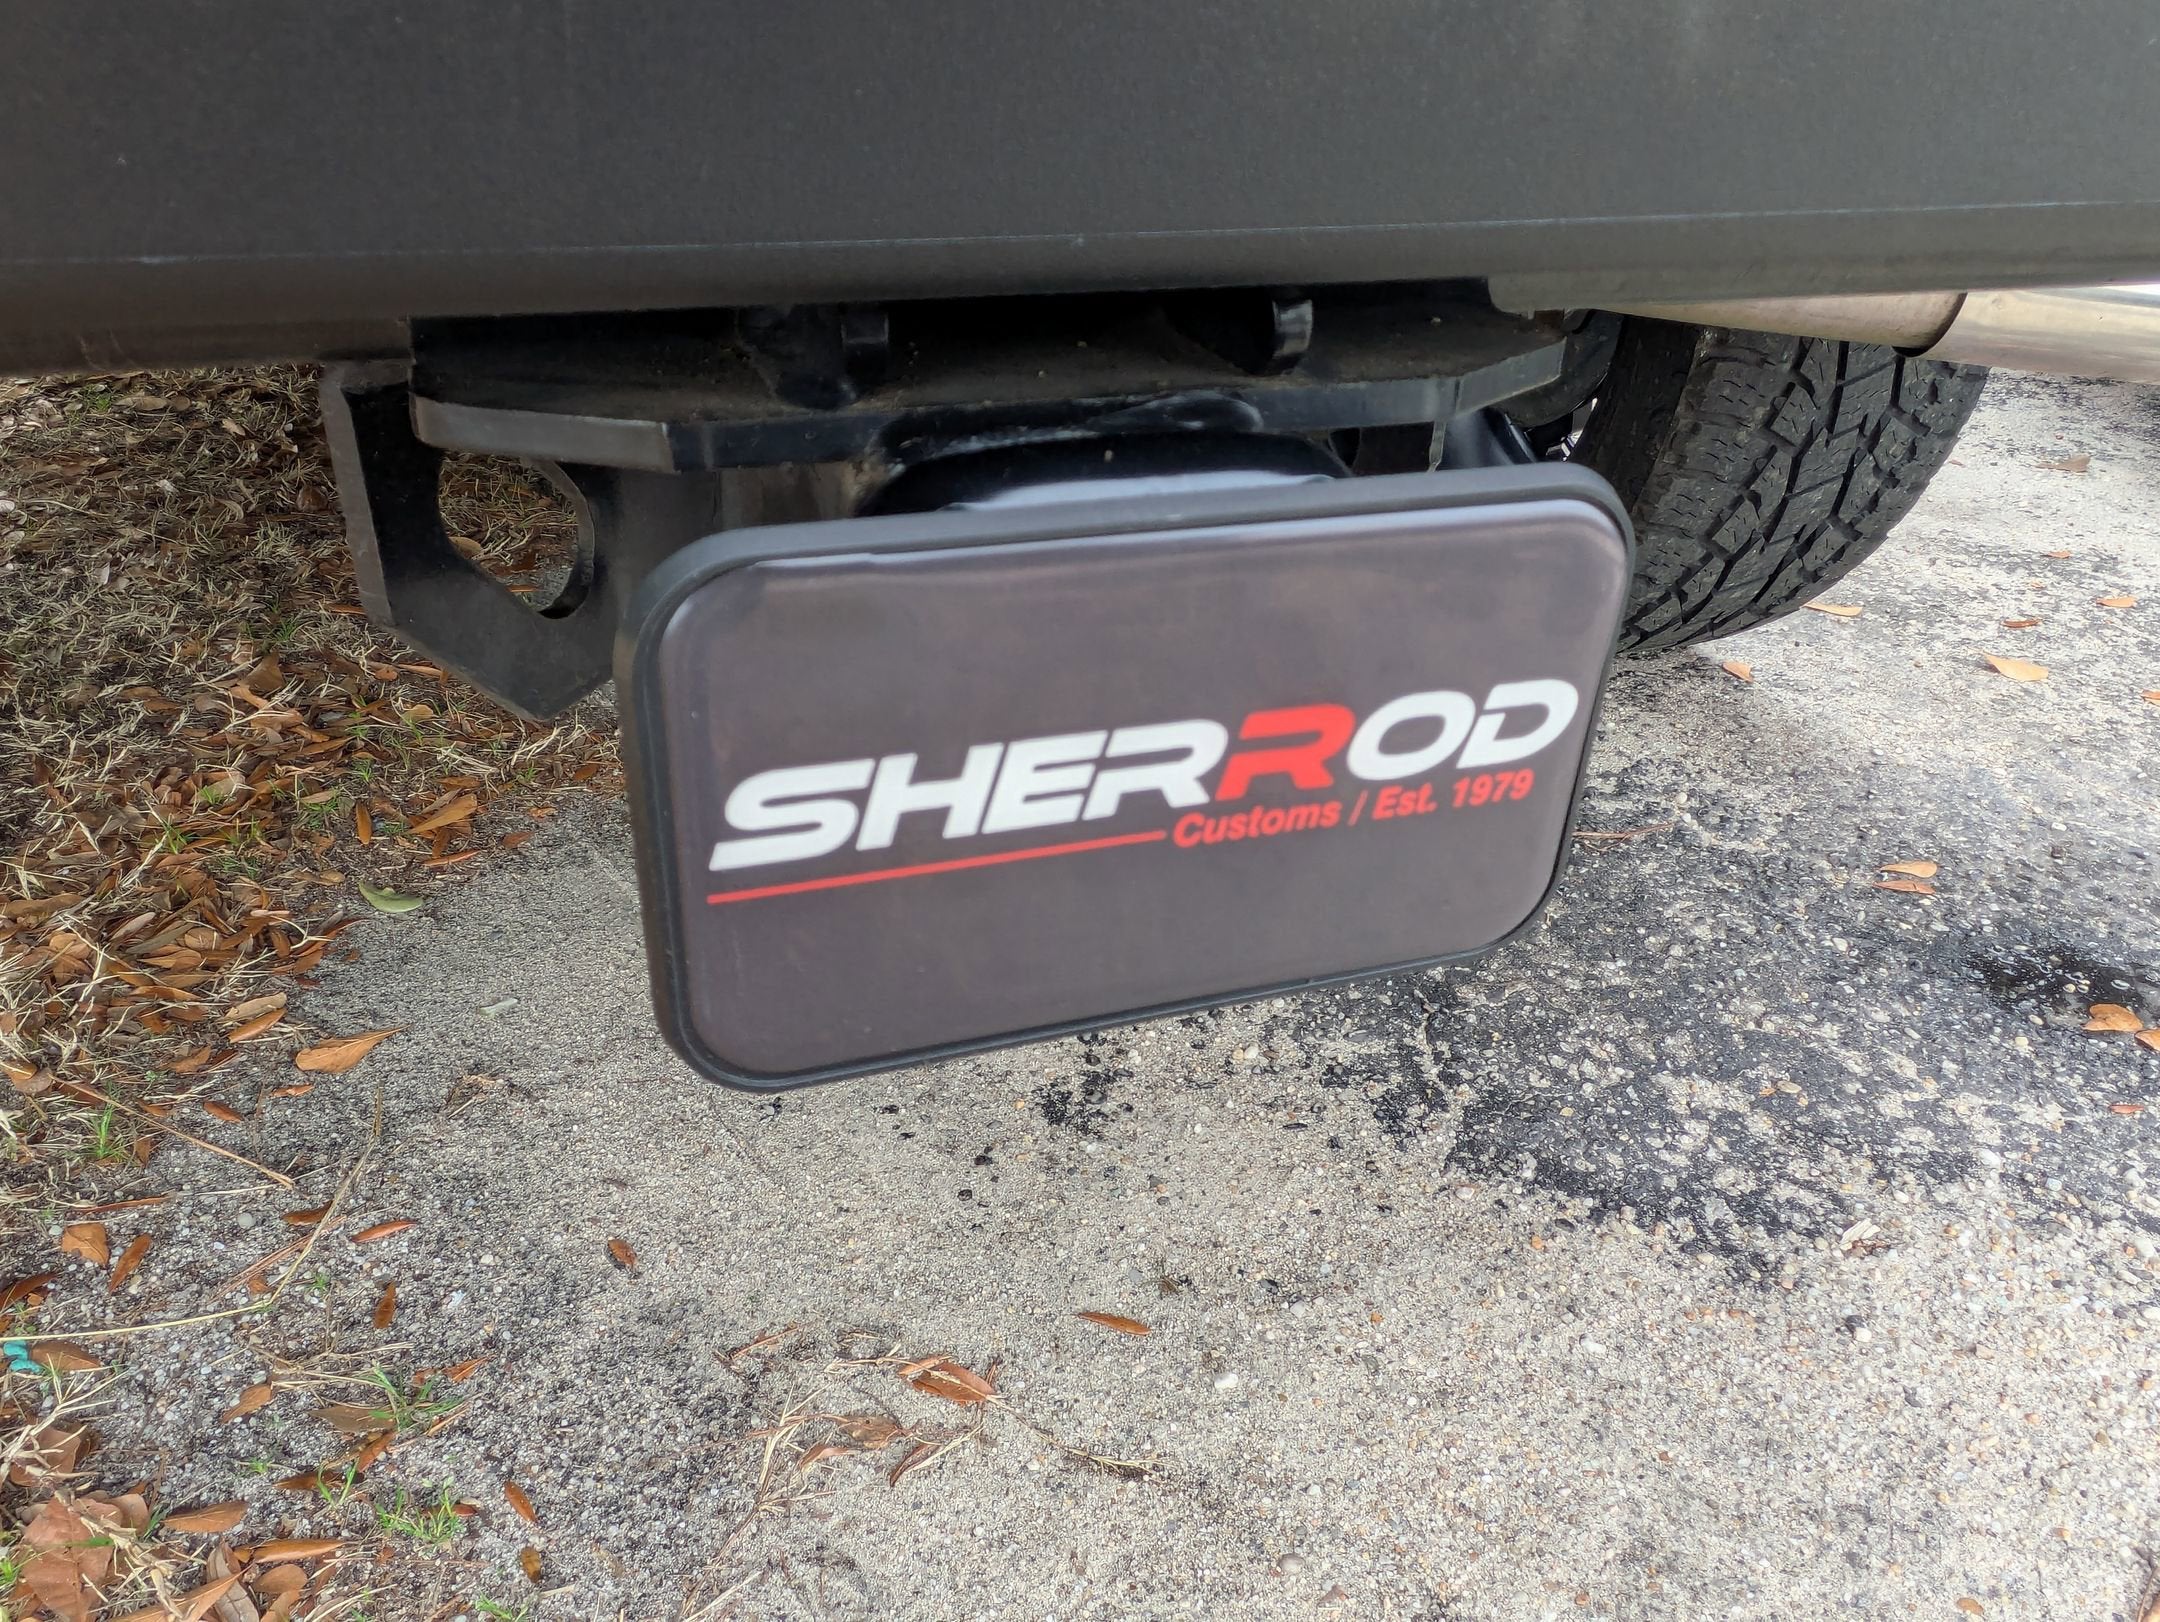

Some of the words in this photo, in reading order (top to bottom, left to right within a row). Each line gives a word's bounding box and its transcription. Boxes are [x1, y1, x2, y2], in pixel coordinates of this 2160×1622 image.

[708, 678, 1580, 871] SHERROD
[1172, 800, 1343, 849] Customs
[1371, 783, 1438, 821] Est.
[1452, 768, 1535, 808] 1979
